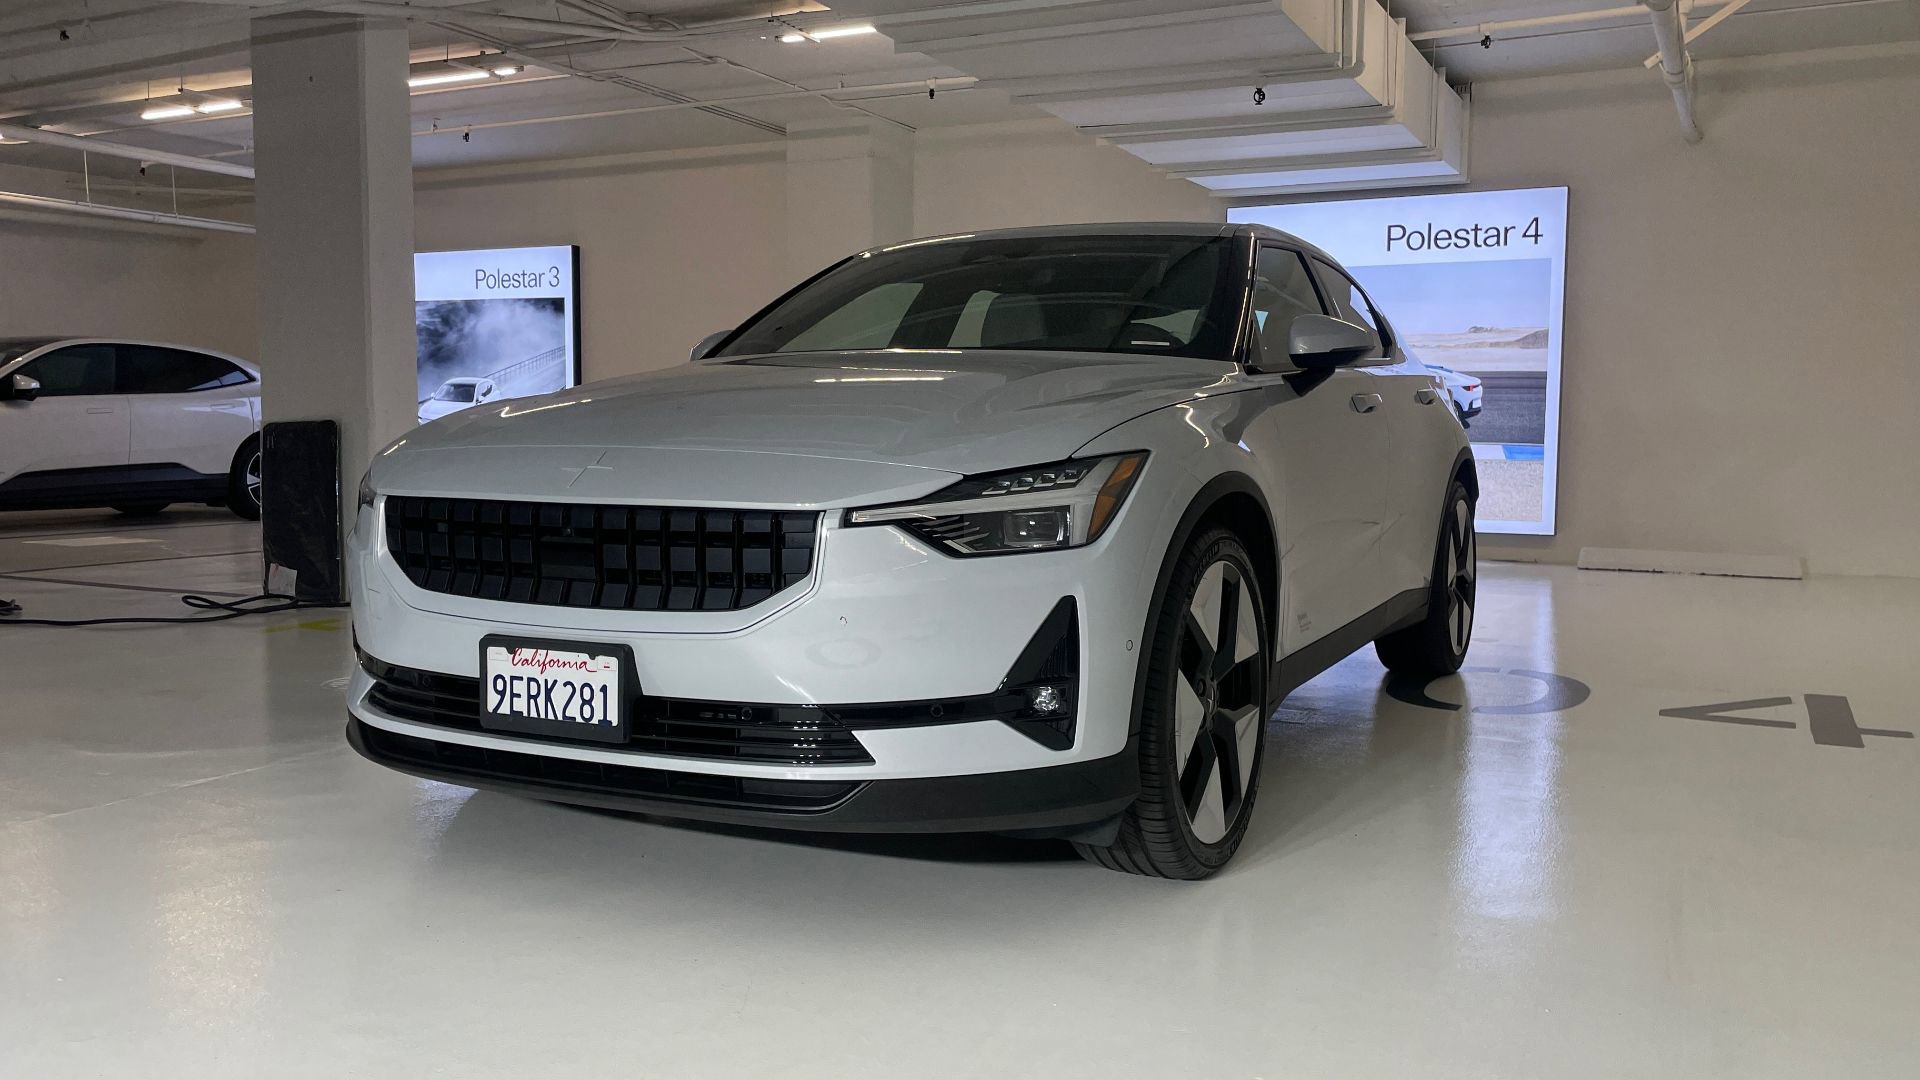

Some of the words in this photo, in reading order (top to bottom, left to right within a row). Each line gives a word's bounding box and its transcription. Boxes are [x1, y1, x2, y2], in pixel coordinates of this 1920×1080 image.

[1386, 222, 1516, 251] Polestar
[1521, 216, 1543, 245] 4
[475, 268, 545, 290] Polestar
[548, 266, 560, 287] 3
[511, 648, 597, 674] California
[492, 673, 613, 725] 9ERK281
